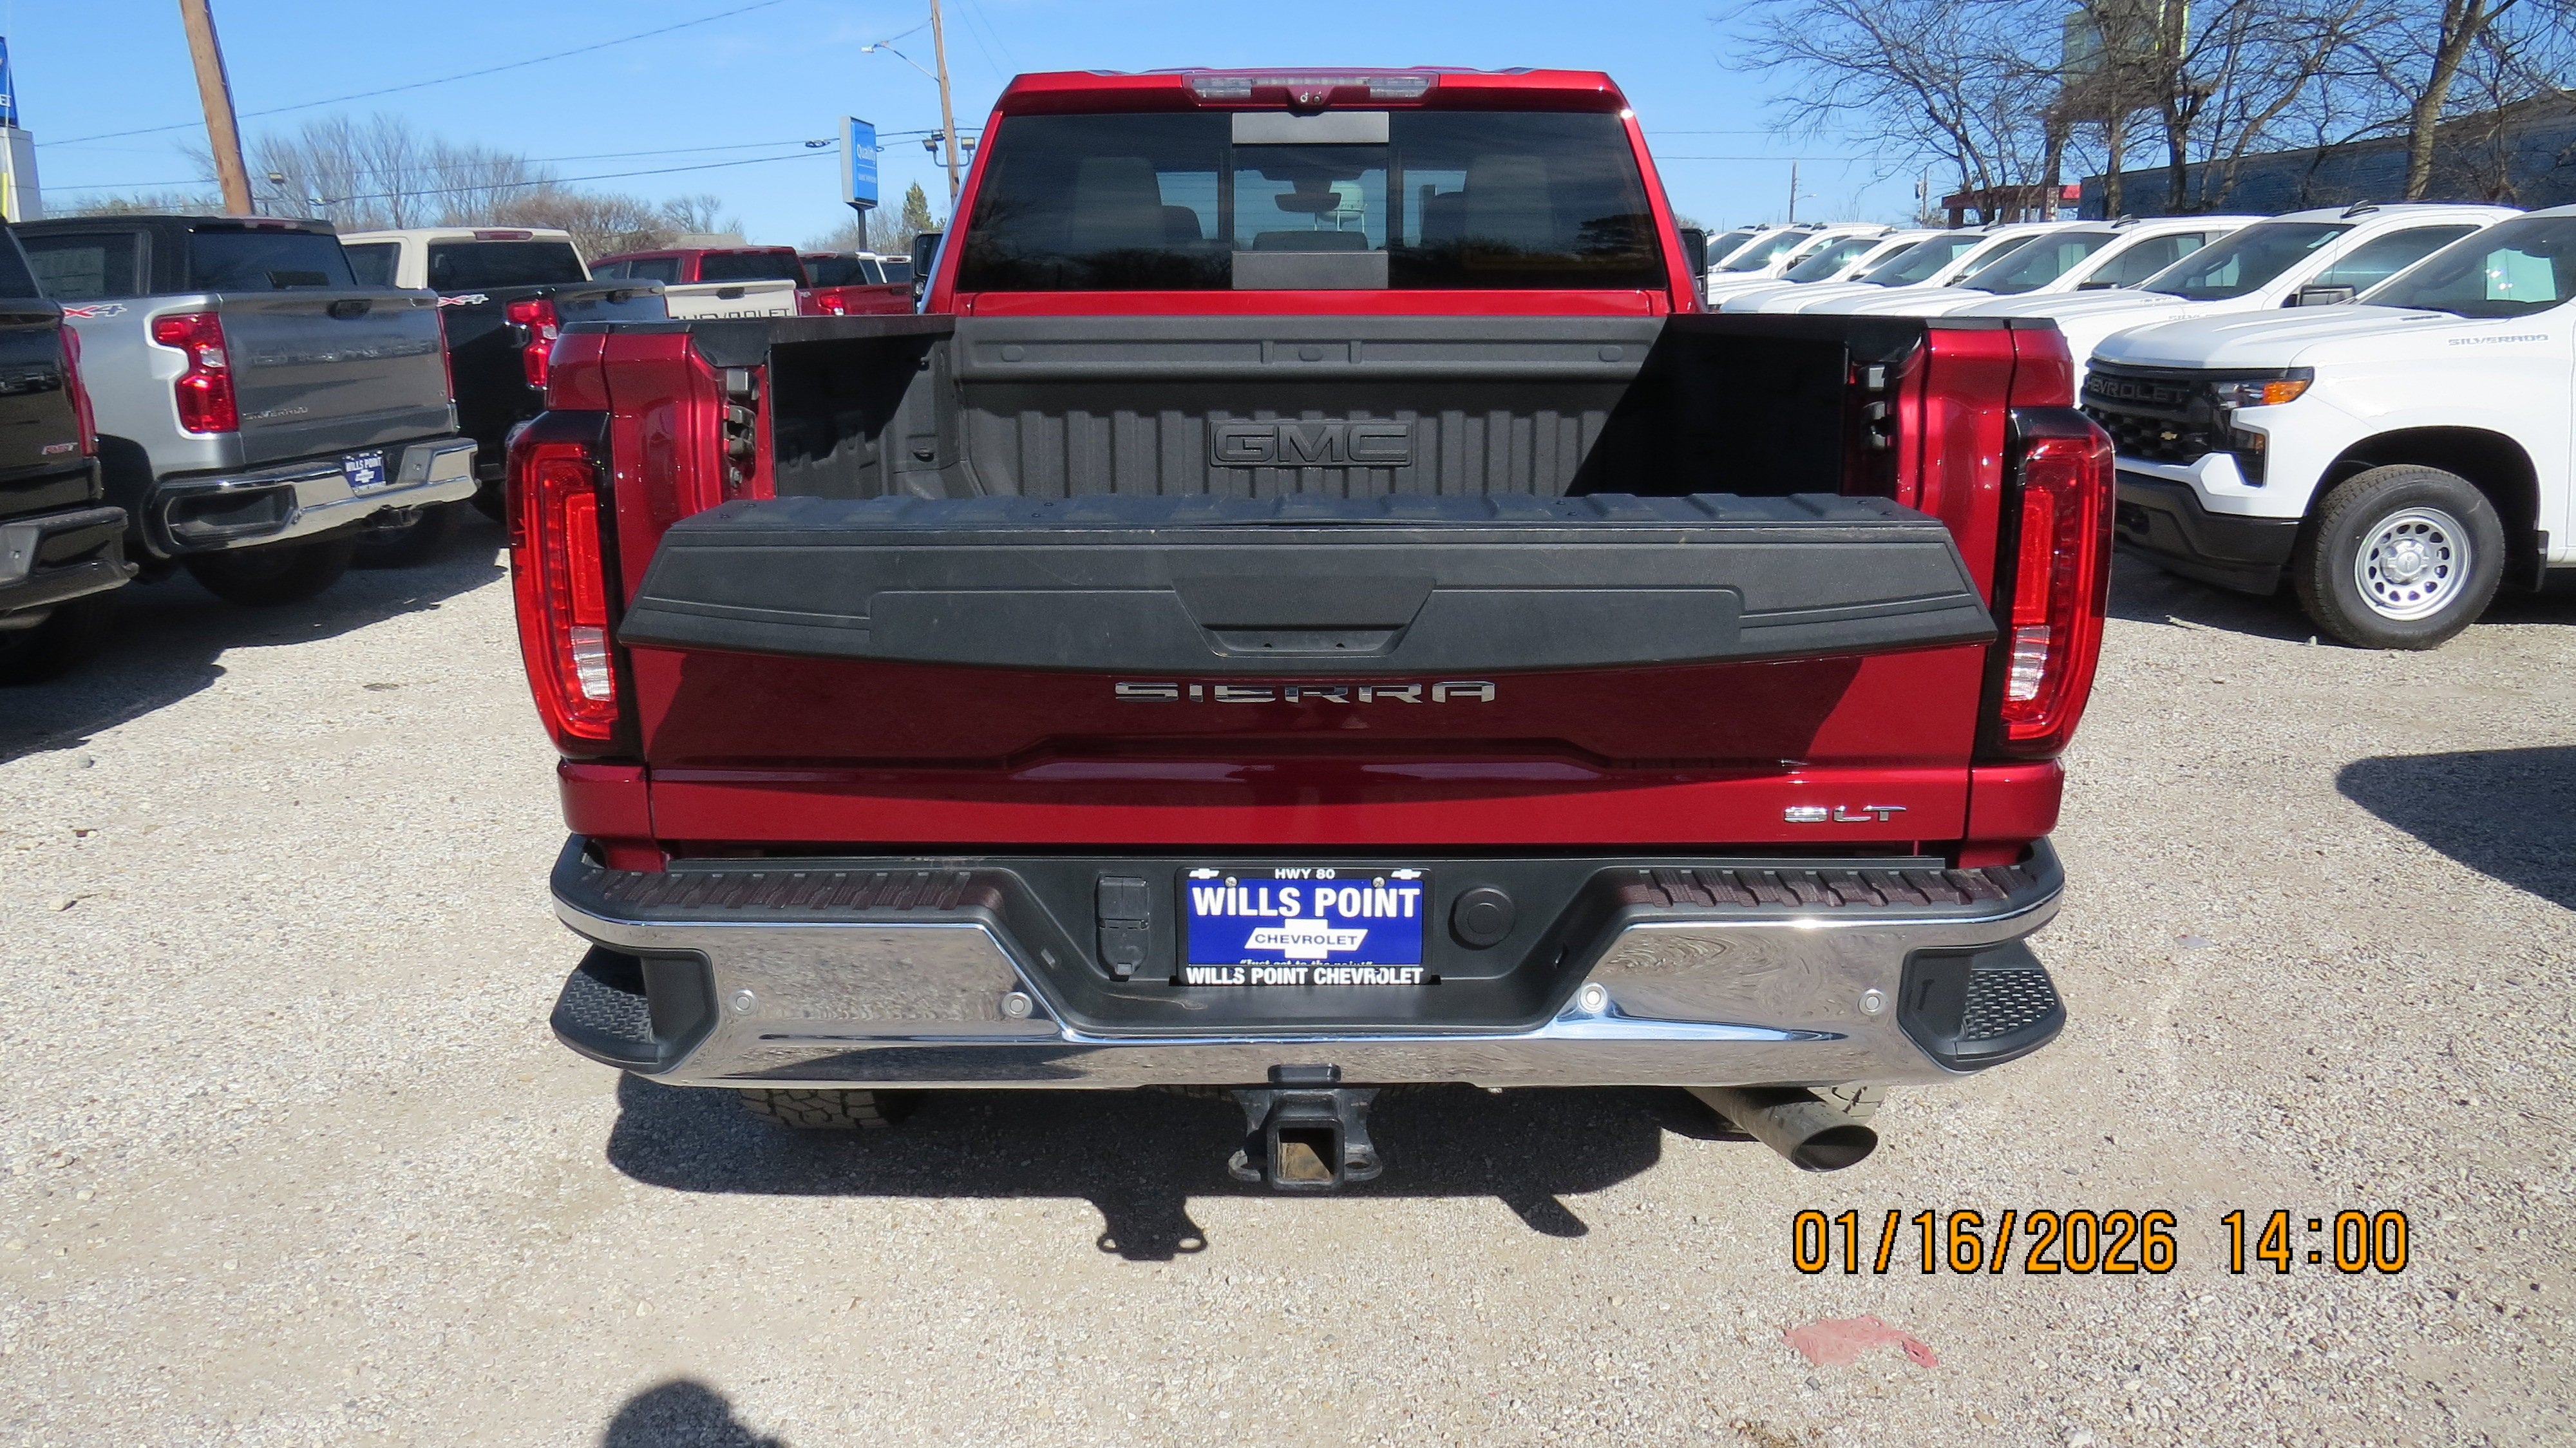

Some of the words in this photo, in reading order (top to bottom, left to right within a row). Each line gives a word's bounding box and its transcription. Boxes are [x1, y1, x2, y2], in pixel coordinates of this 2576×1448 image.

[2448, 334, 2549, 346] SILVERADO
[1214, 423, 1408, 463] GMC
[1115, 681, 1495, 703] SIERRA
[1784, 805, 1907, 823] SLT
[1274, 868, 1312, 880] HWY
[1316, 868, 1336, 880] 80
[1191, 887, 1302, 917] WILLS
[1314, 887, 1421, 918] POINT
[1254, 933, 1358, 946] CHEVROLET
[1186, 967, 1245, 985] WILLS
[1250, 967, 1309, 985] POINT
[1313, 967, 1424, 985] CHEVROLET
